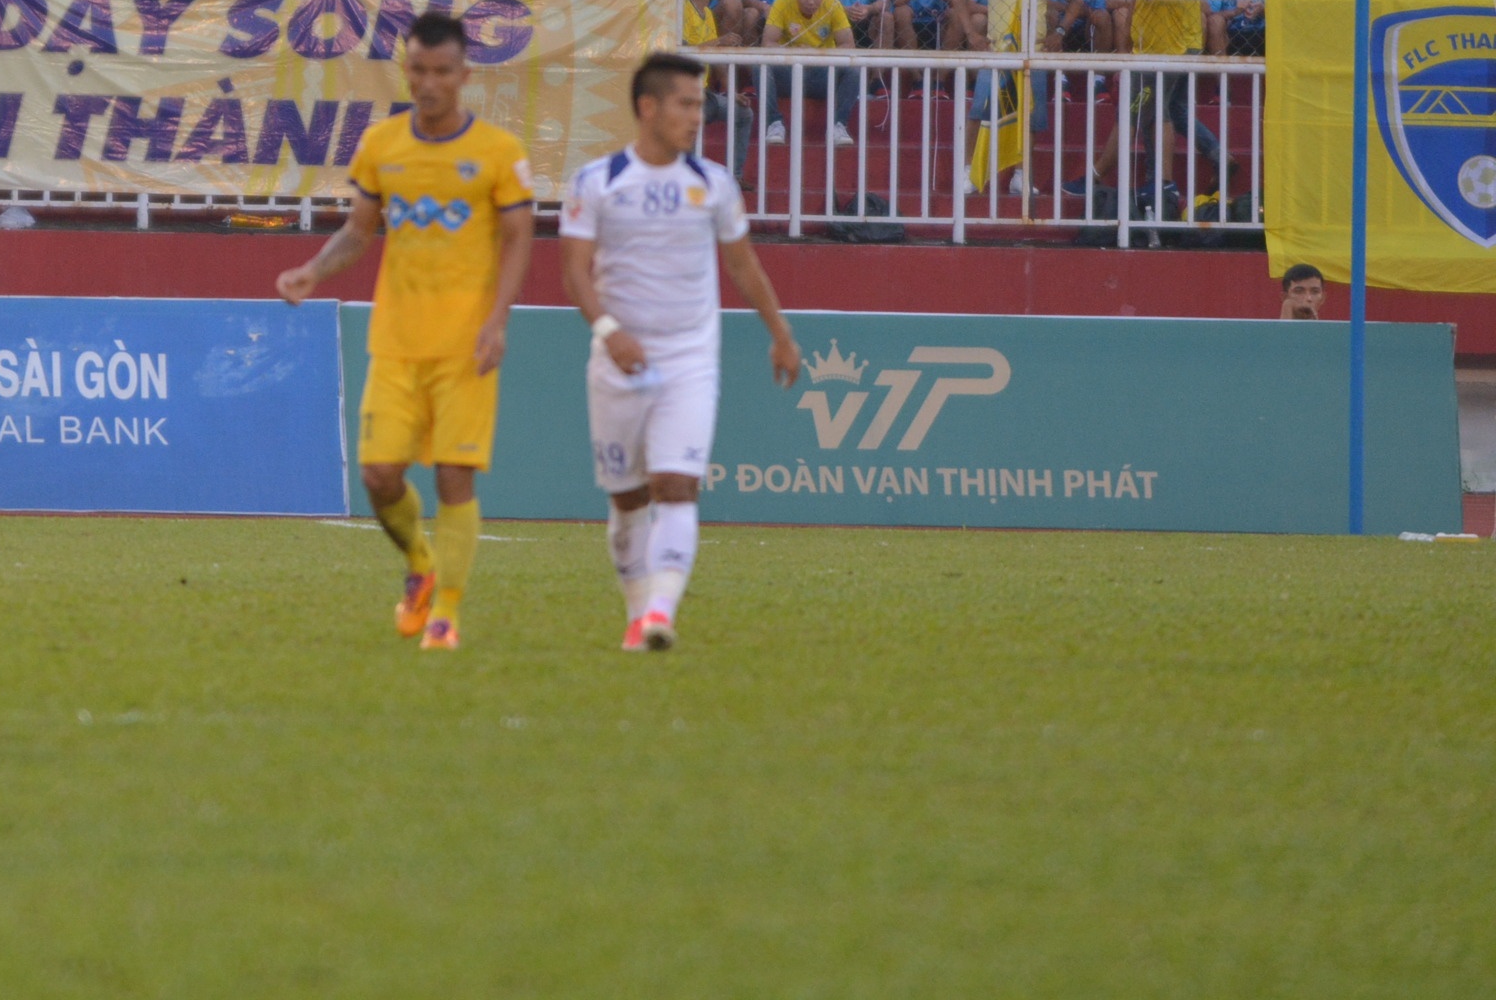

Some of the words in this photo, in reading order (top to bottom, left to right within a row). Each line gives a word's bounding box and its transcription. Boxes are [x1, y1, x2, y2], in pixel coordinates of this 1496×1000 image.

[1403, 40, 1440, 70] FLC
[1447, 32, 1496, 50] THA
[643, 180, 682, 217] 89
[76, 339, 168, 400] GÒN
[59, 414, 170, 446] BANK
[735, 458, 844, 494] ĐOÀN
[852, 466, 929, 503] VẠN
[936, 467, 1053, 504] THỊNH
[1064, 463, 1159, 499] PHÁT
